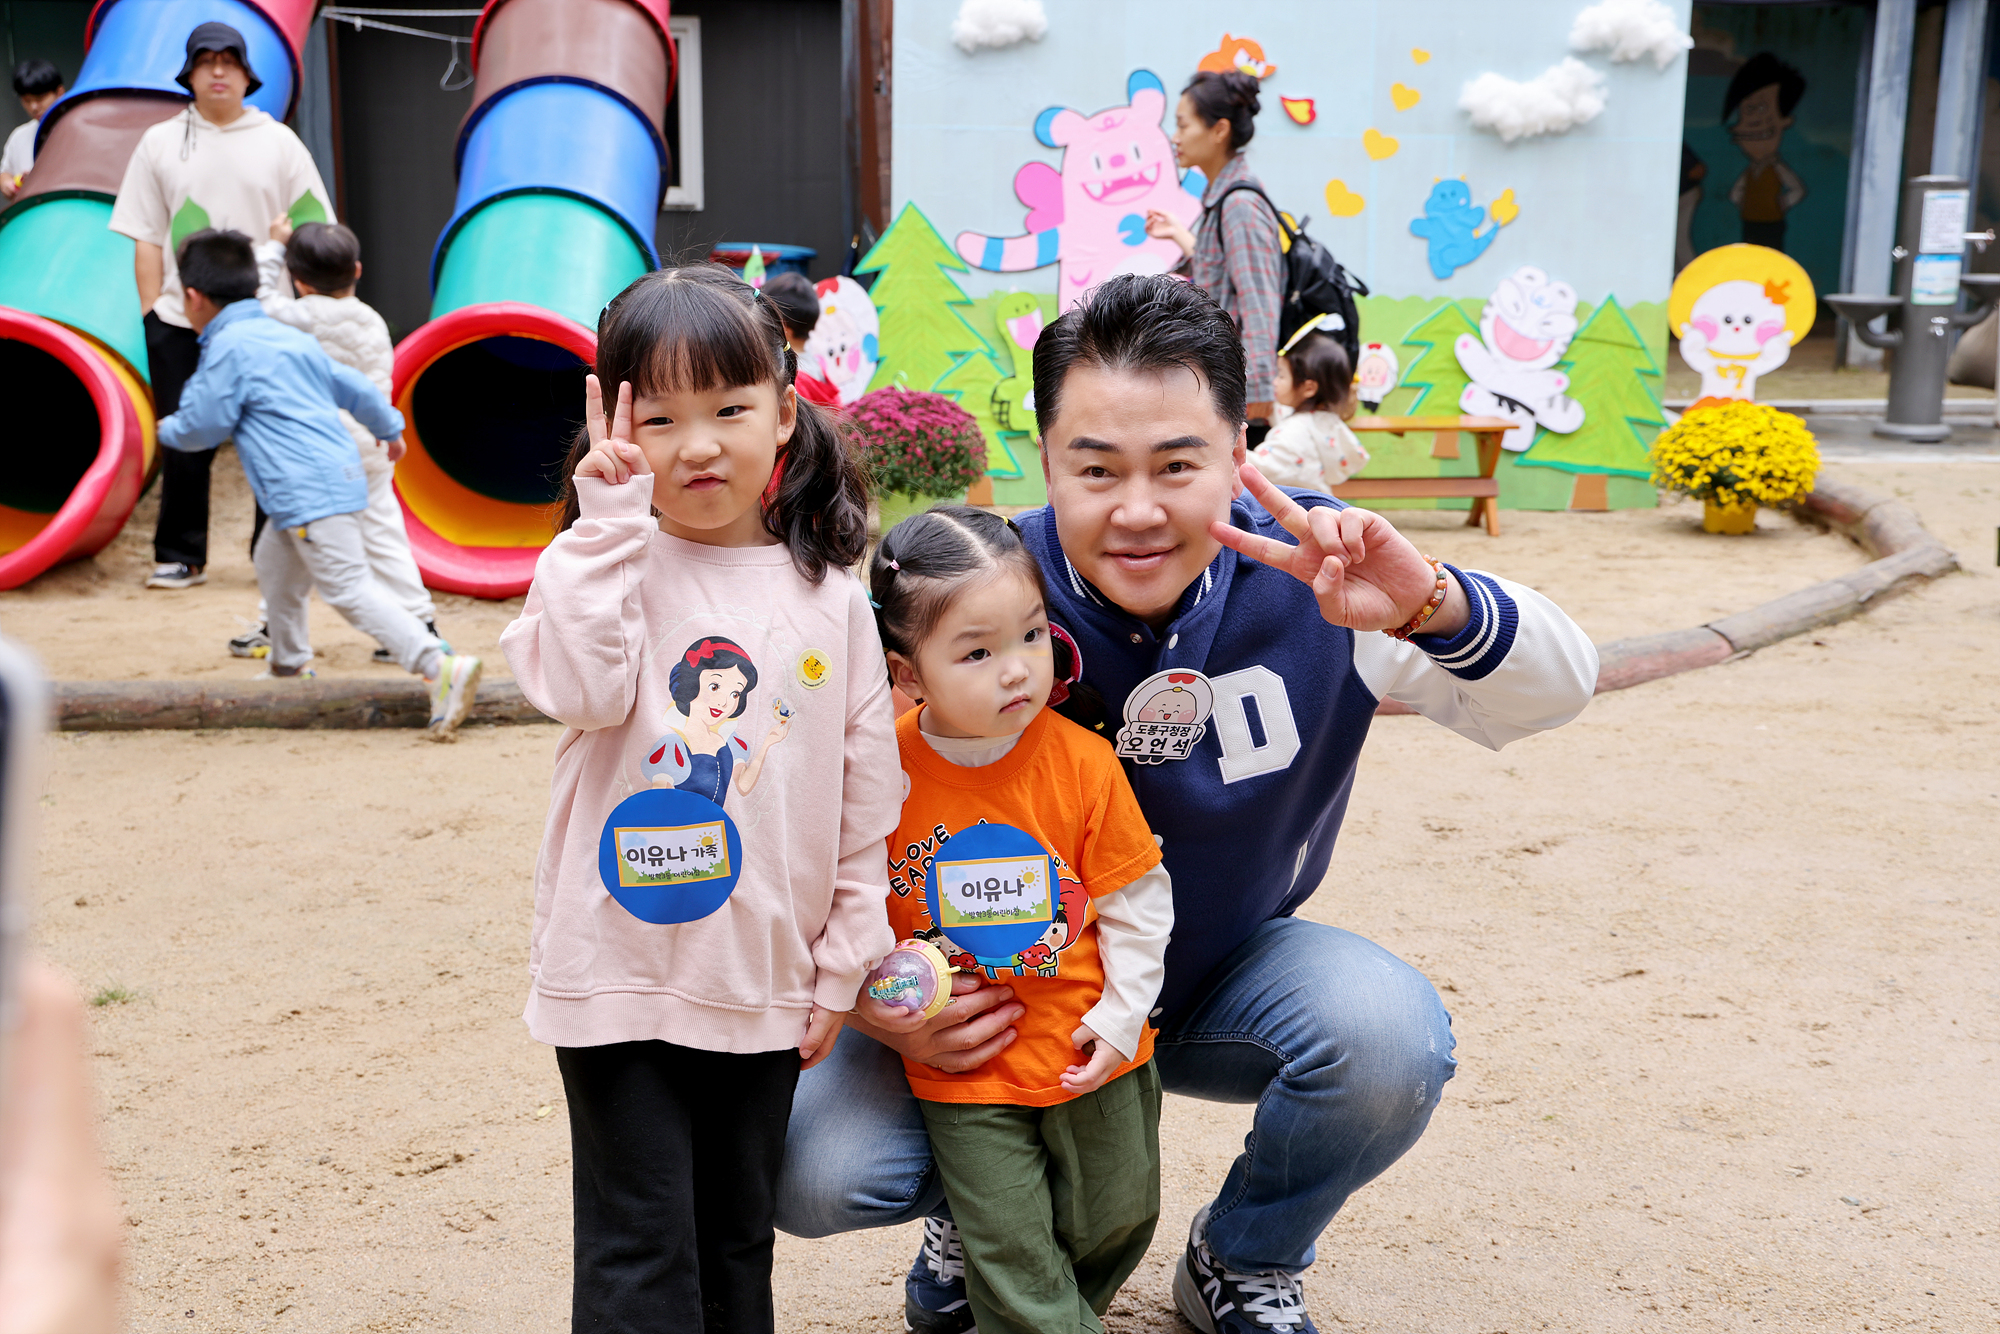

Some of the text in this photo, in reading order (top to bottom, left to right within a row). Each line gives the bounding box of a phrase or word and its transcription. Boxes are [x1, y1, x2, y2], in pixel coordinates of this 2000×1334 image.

[1135, 724, 1191, 737] 도봉구청장
[1210, 664, 1301, 785] D
[626, 844, 718, 867] 이유나 가족
[889, 823, 951, 872] LOVE
[961, 877, 1025, 902] 이유나
